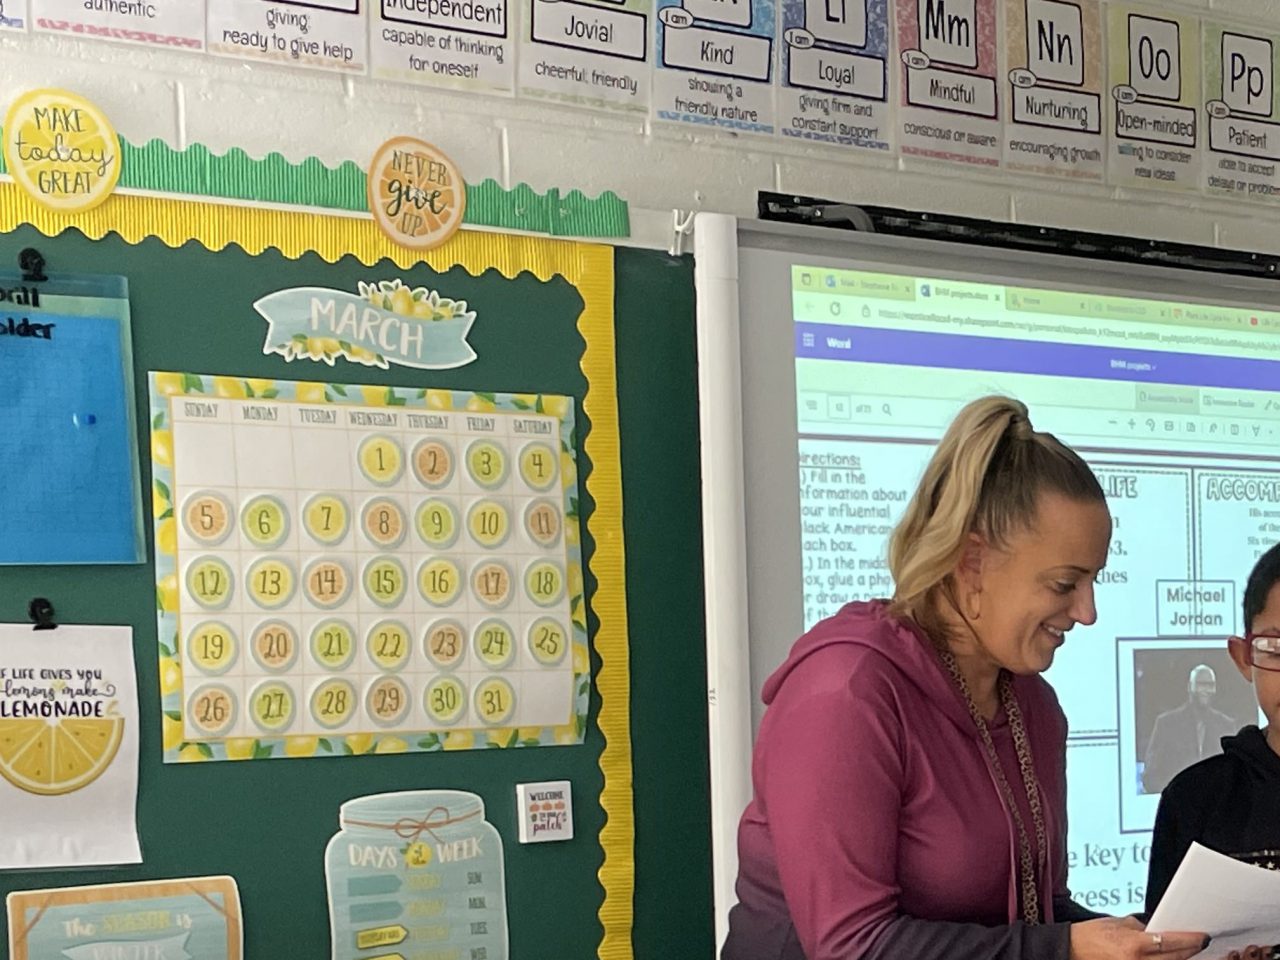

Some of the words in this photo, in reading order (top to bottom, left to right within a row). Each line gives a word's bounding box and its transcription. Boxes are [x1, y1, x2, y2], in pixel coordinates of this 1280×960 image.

[563, 15, 613, 43] Jovial
[674, 13, 690, 25] am
[926, 0, 972, 48] Mm
[223, 29, 269, 52] ready
[272, 33, 287, 50] to
[290, 37, 320, 59] give
[323, 39, 353, 62] help
[382, 27, 435, 49] capable
[438, 34, 452, 50] of
[454, 37, 504, 64] thinking
[701, 41, 735, 66] Kind
[1037, 20, 1073, 67] Nn
[409, 55, 430, 71] for
[432, 60, 479, 79] oneself
[1138, 36, 1171, 81] Oo
[591, 68, 638, 97] friendly
[818, 60, 855, 88] Loyal
[1230, 53, 1264, 105] Pp
[688, 77, 733, 101] showing
[929, 79, 976, 106] Mindful
[33, 107, 87, 132] MAKE
[675, 97, 718, 120] friendly
[720, 105, 758, 123] nature
[1026, 96, 1088, 131] Nurturing
[1117, 108, 1194, 139] Open-minded
[1228, 126, 1267, 149] Patient
[15, 130, 115, 177] today
[38, 169, 93, 194] GREAT
[392, 150, 448, 186] NEVER
[386, 179, 448, 217] give
[401, 212, 423, 238] UP
[311, 297, 423, 359] MARCH
[826, 337, 852, 350] Word
[375, 448, 386, 470] 1
[427, 451, 441, 475] 2
[480, 451, 492, 476] 3
[531, 454, 543, 477] 4
[811, 471, 828, 485] Fill
[831, 472, 842, 484] in
[845, 472, 866, 485] the
[872, 488, 907, 502] about
[199, 505, 214, 530] 5
[258, 510, 271, 534] 6
[320, 507, 333, 530] 7
[378, 510, 390, 534] 8
[431, 511, 443, 534] 9
[479, 511, 499, 534] 10
[536, 511, 551, 533] 11
[828, 504, 891, 519] influential
[834, 523, 894, 537] American
[830, 540, 858, 552] box.
[198, 570, 223, 596] 12
[259, 570, 281, 594] 13
[316, 570, 337, 594] 14
[375, 569, 395, 594] 15
[429, 569, 449, 592] 16
[482, 572, 501, 595] 17
[536, 571, 555, 594] 18
[1167, 586, 1226, 603] Michael
[1170, 611, 1223, 626] Jordan
[202, 635, 224, 660] 19
[264, 633, 288, 659] 20
[324, 632, 343, 656] 21
[379, 633, 401, 658] 22
[437, 633, 456, 656] 23
[482, 631, 505, 655] 24
[534, 627, 560, 654] 25
[12, 668, 35, 681] LIFE
[40, 668, 73, 681] GIVES
[77, 668, 102, 681] YOU
[62, 681, 116, 699] make
[0, 700, 104, 718] LEMONADE
[200, 698, 226, 722] 26
[262, 695, 285, 720] 27
[321, 690, 347, 716] 28
[377, 688, 400, 713] 29
[434, 688, 457, 712] 30
[485, 690, 505, 714] 31
[533, 819, 563, 837] patch
[348, 843, 398, 869] DAYS
[436, 837, 484, 864] WEEK
[1084, 843, 1125, 871] key
[1127, 881, 1145, 904] is
